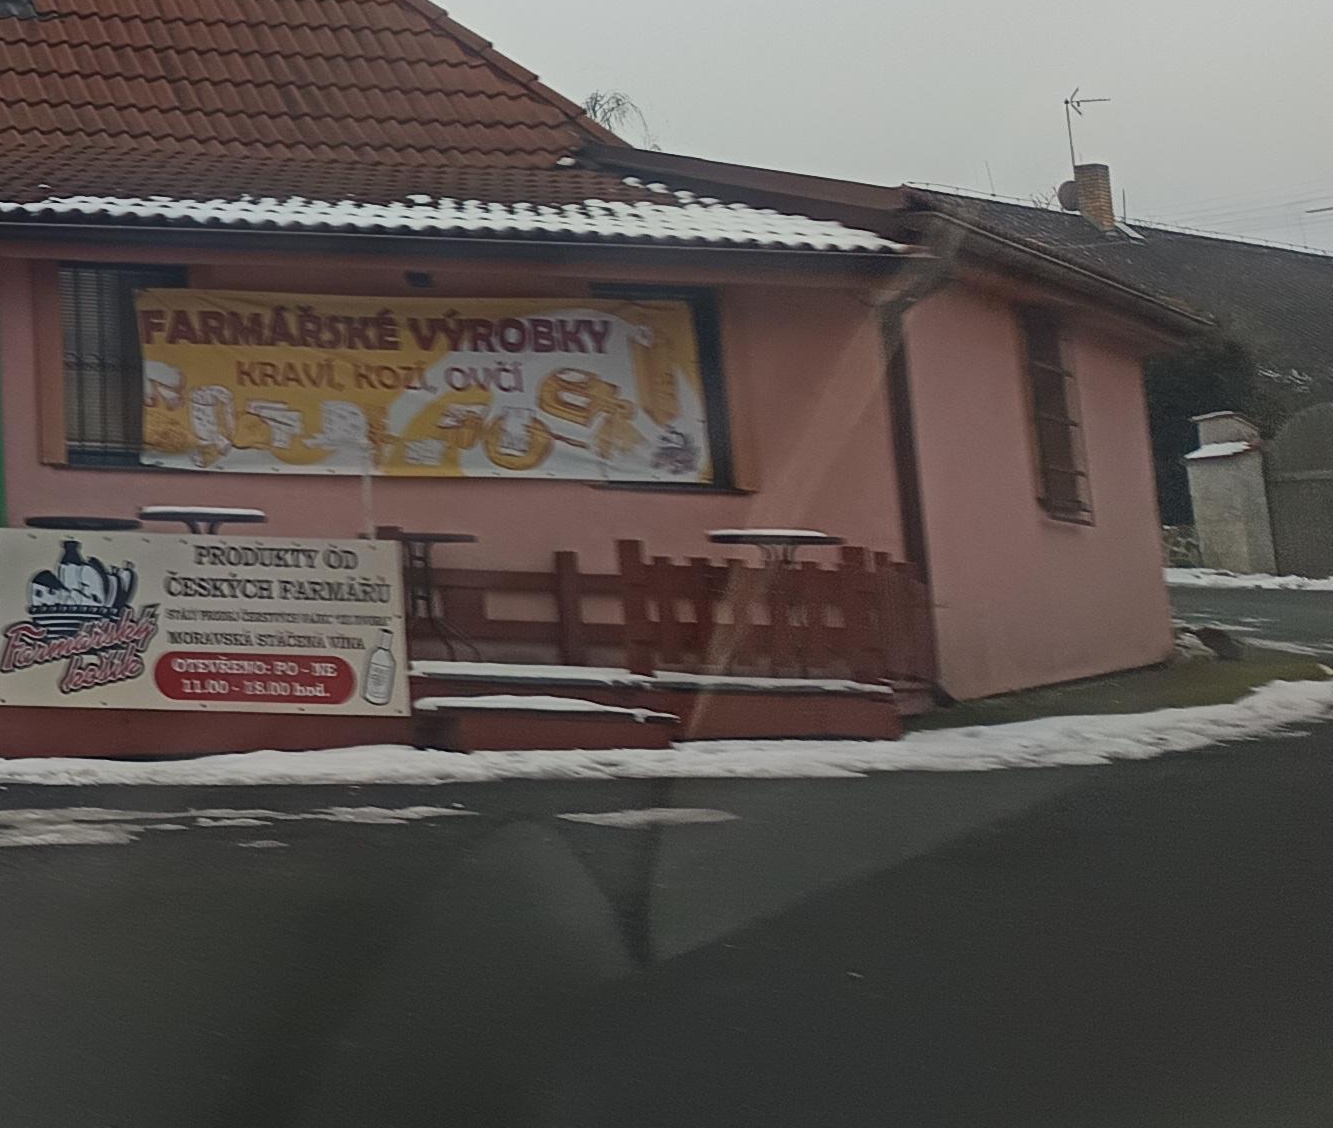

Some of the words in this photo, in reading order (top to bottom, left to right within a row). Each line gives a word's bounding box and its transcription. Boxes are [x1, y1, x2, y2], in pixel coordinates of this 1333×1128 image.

[138, 305, 401, 351] FARMÁŘSKÉ
[406, 308, 610, 353] VÝROBKY
[194, 544, 319, 568] PRODUKTY
[165, 571, 274, 600] ČESKÝCH
